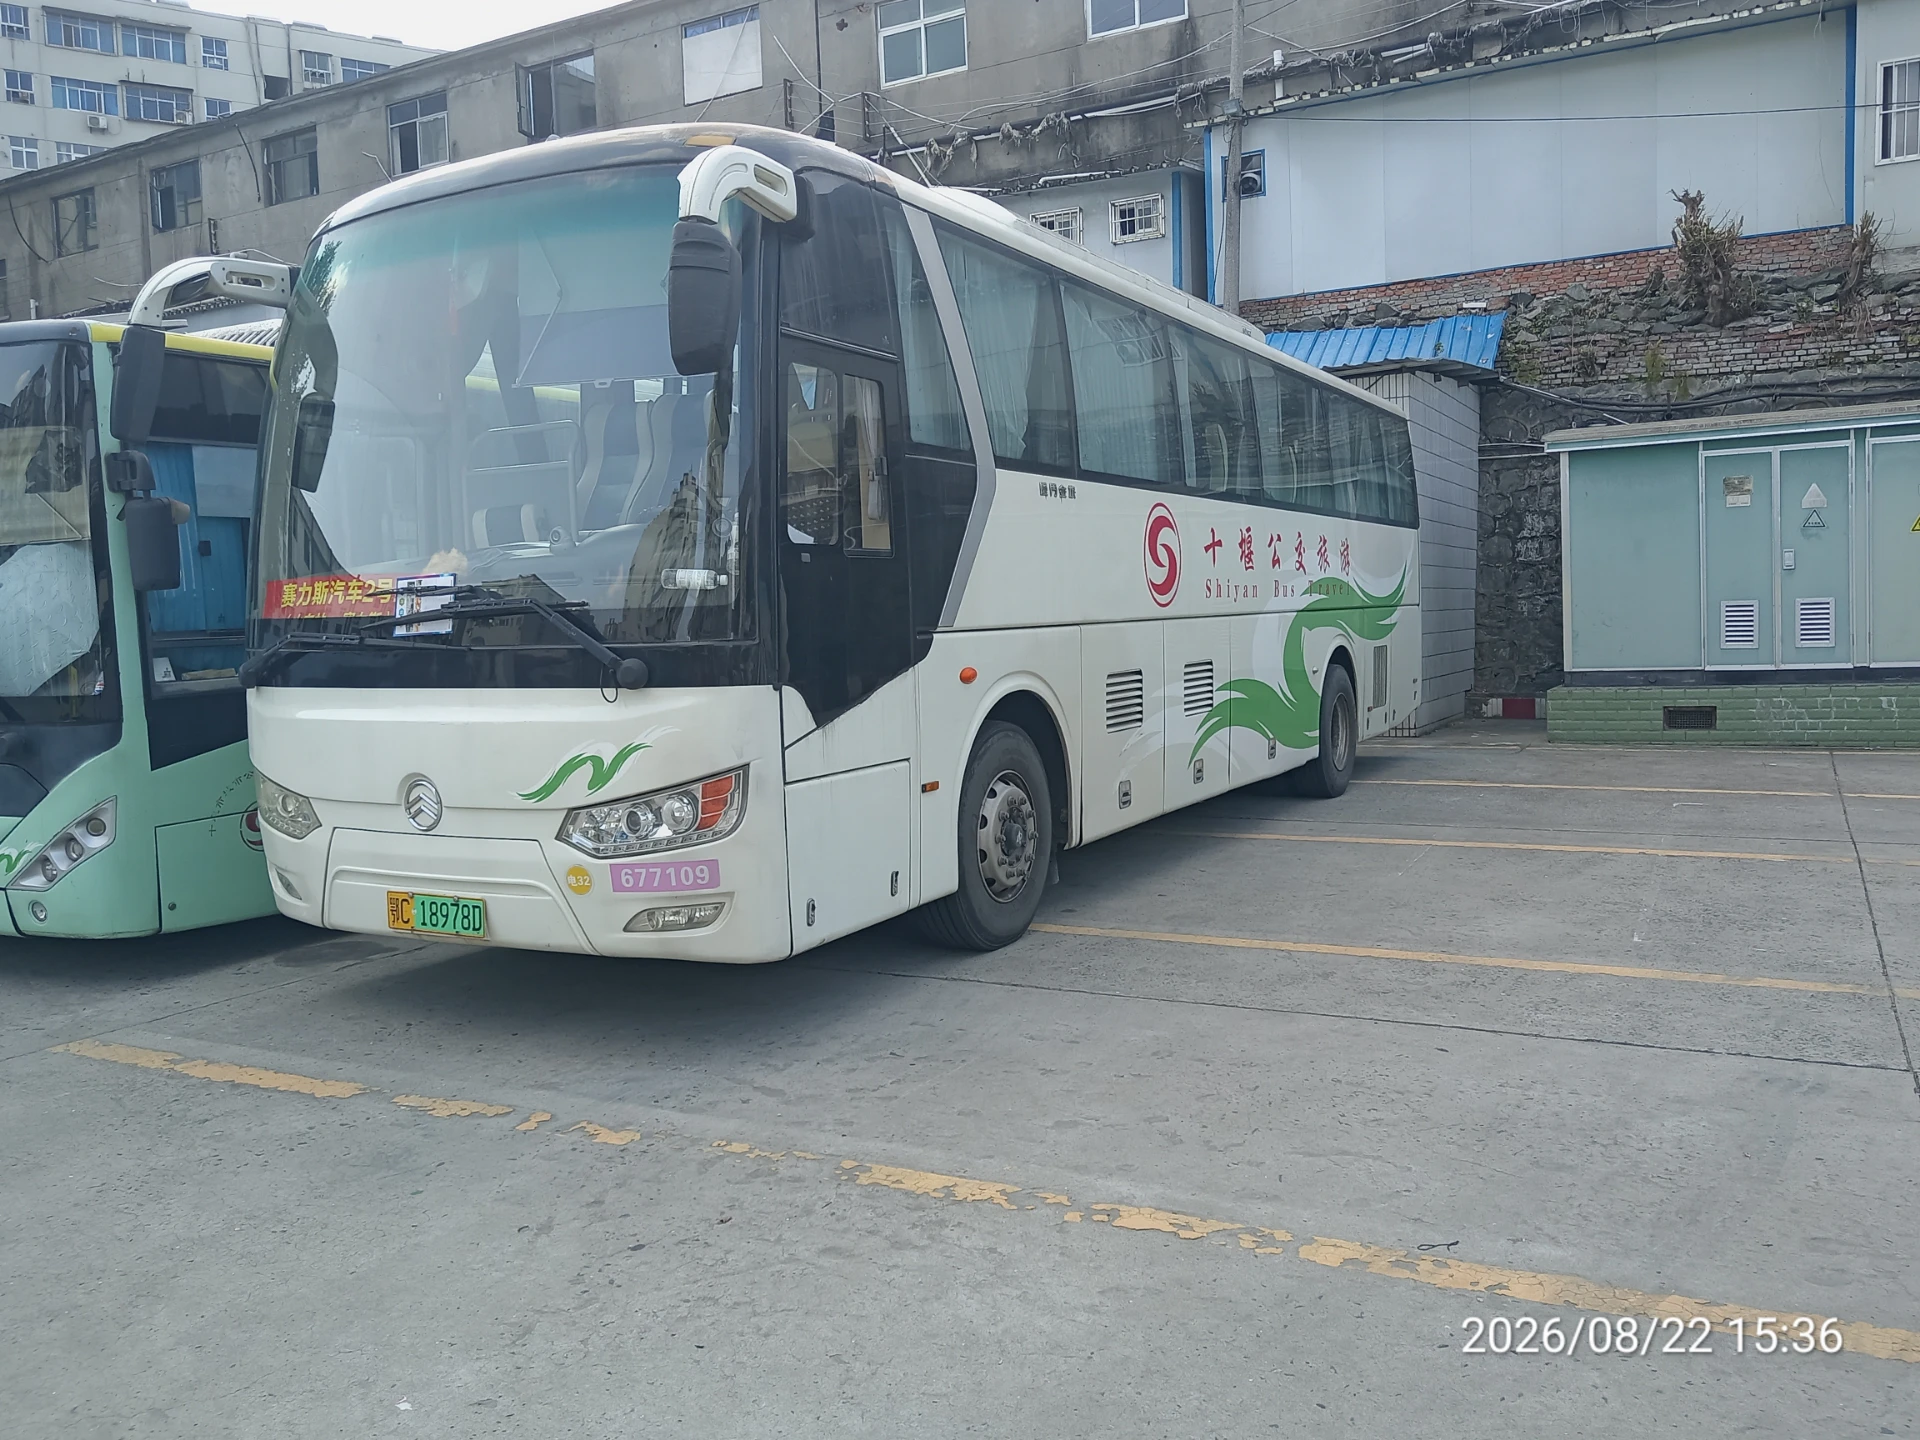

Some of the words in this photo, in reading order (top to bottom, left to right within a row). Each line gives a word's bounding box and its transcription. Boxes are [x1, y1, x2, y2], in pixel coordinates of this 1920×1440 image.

[1204, 526, 1351, 576] 十堰公交旅游
[280, 577, 396, 608] 赛力斯汽车2号
[1205, 578, 1258, 603] Shiyan
[1273, 579, 1295, 598] Bus
[1308, 580, 1350, 597] Travel
[567, 875, 591, 887] 电32
[620, 865, 710, 888] 677109
